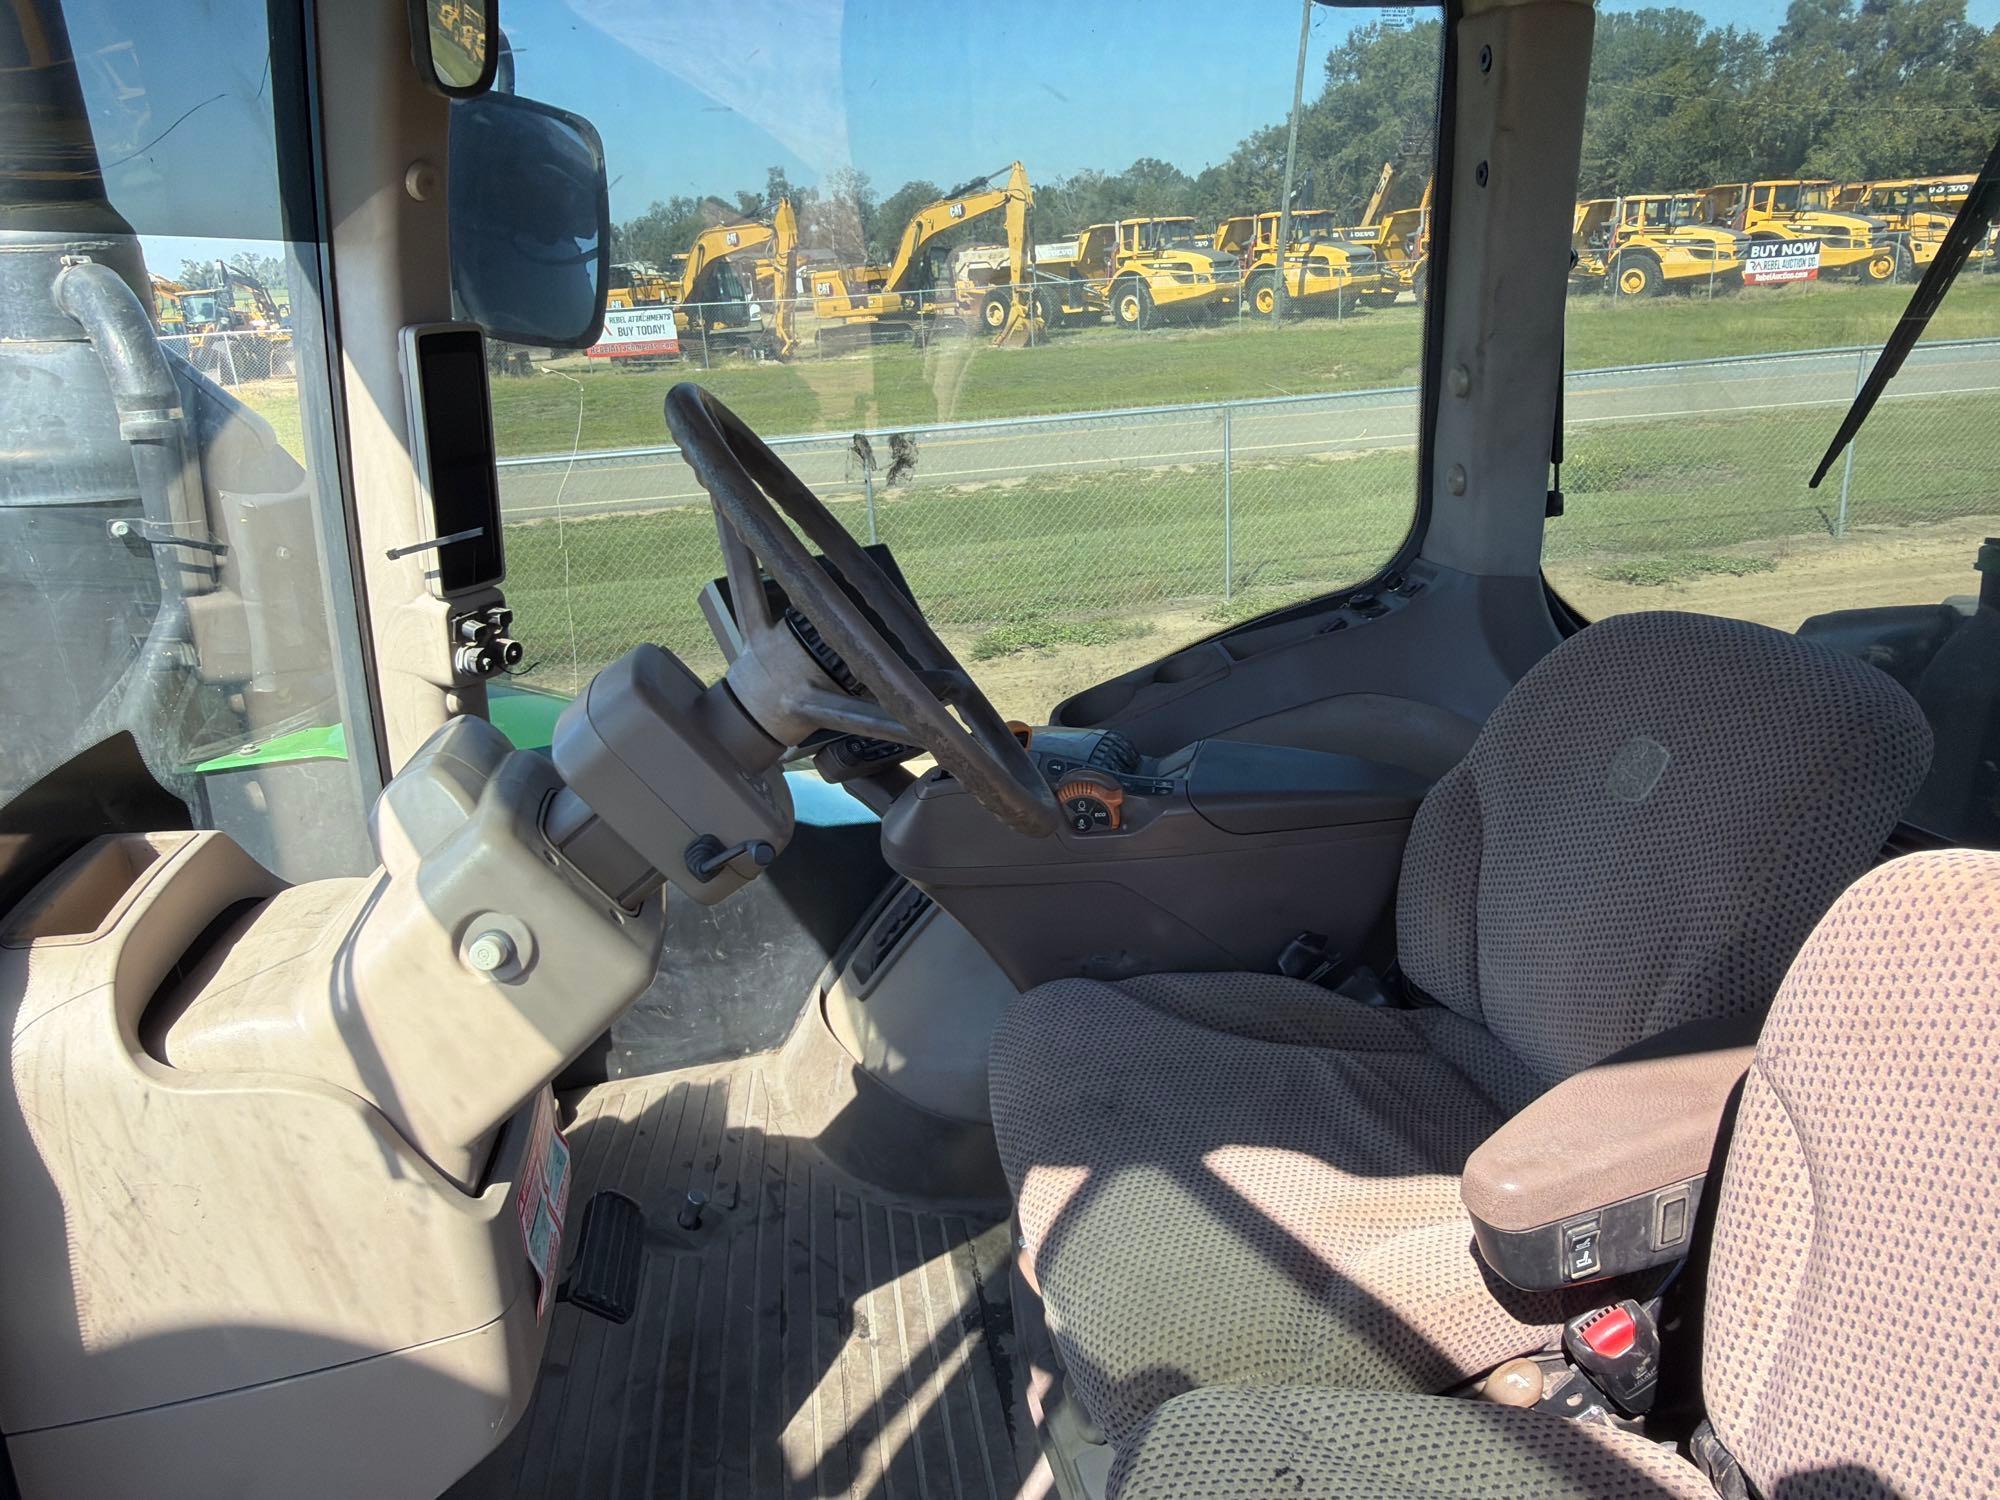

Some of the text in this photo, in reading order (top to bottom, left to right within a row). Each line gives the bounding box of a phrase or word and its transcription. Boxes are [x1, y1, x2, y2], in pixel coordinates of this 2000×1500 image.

[1750, 241, 1818, 258] BUY NOW
[1763, 259, 1780, 270] REBEL
[1781, 257, 1806, 269] AUCTION
[609, 313, 671, 324] REBEL ATTACHMENTS
[617, 324, 666, 337] BUY TODAY!
